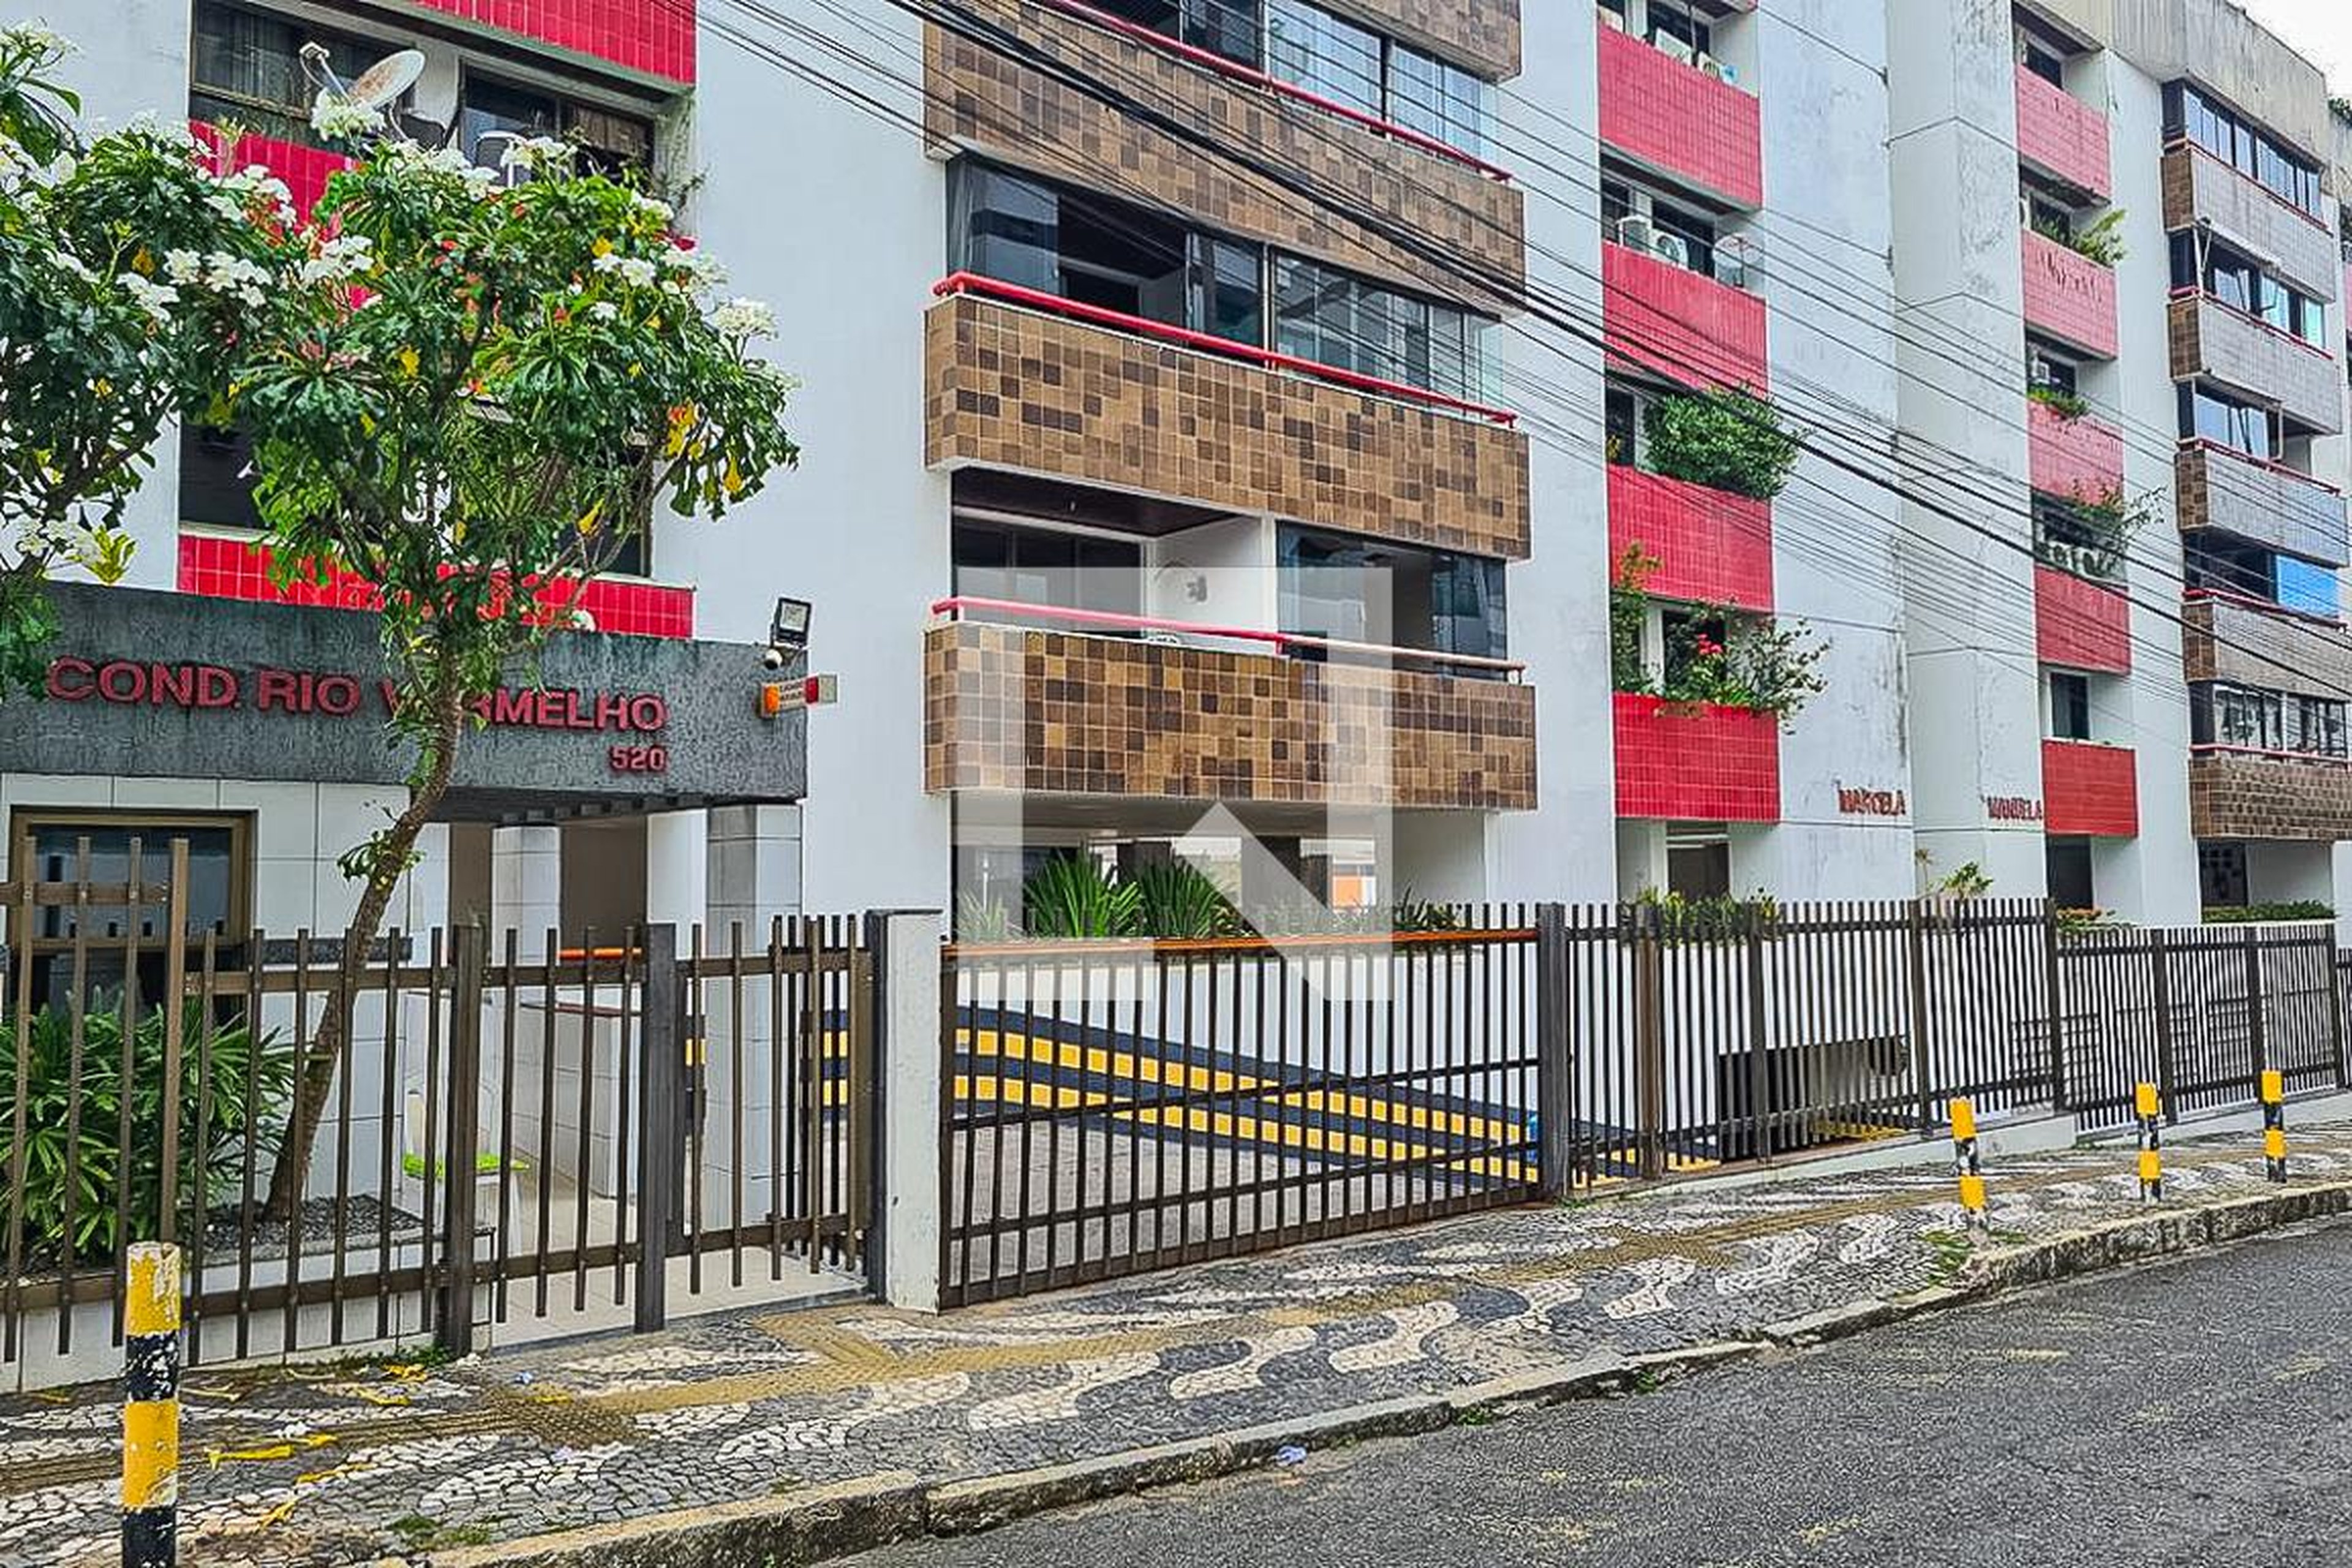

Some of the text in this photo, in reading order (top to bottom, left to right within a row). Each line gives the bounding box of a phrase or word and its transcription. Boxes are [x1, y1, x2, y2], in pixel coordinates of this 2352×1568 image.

[47, 655, 668, 732] COND. RIO VMELHO
[609, 745, 667, 774] 520
